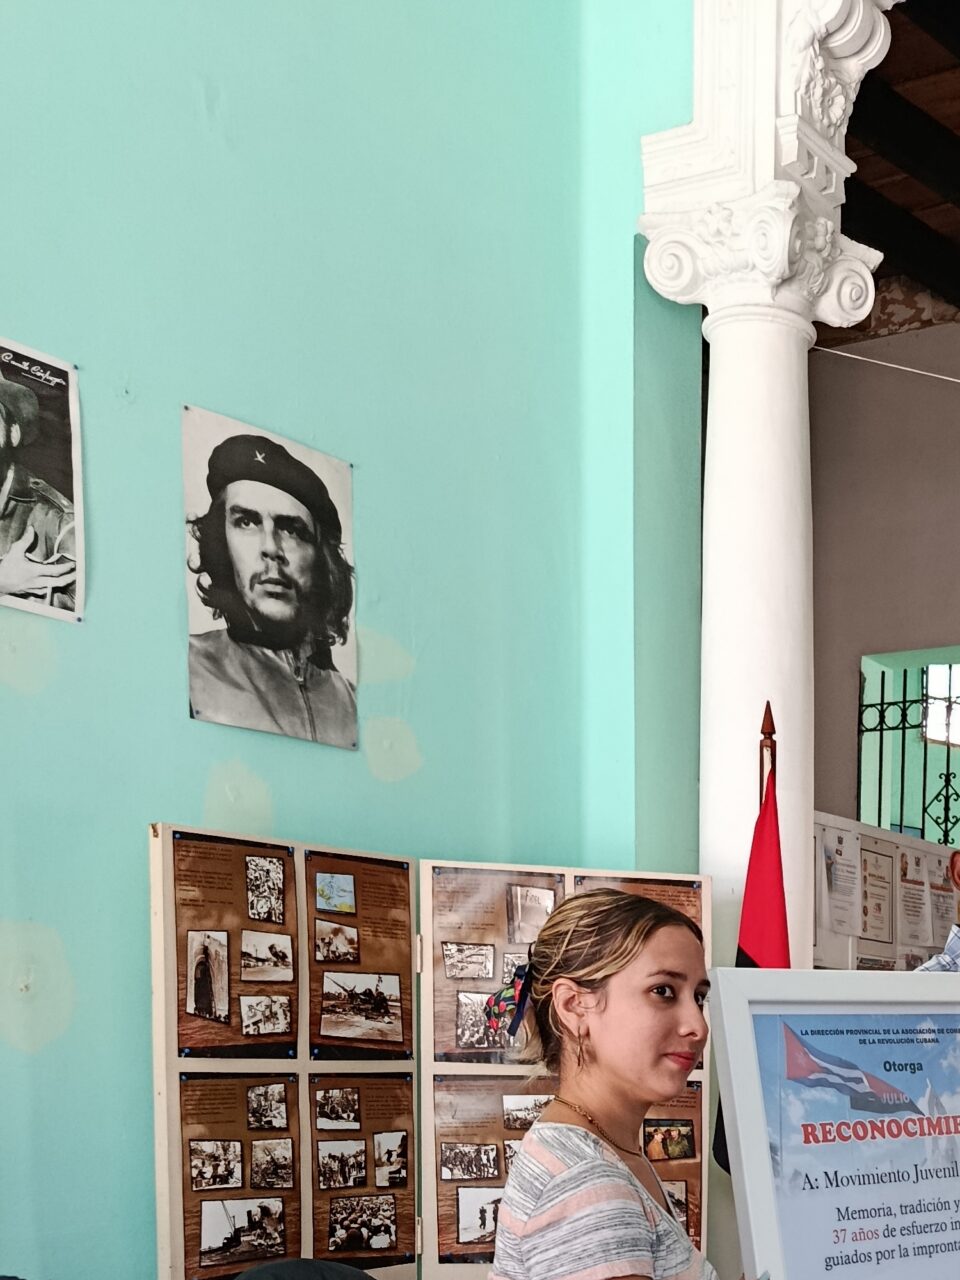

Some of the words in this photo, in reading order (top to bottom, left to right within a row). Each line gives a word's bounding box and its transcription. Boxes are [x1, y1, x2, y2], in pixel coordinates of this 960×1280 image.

[810, 1028, 845, 1036] DIRECCIÓN
[901, 1027, 936, 1035] ASOCIACIÓN
[878, 1036, 916, 1045] REVOLUCIÓN
[883, 1060, 924, 1075] Otorga
[881, 1092, 910, 1105] JULIO
[802, 1172, 820, 1191] A:
[823, 1166, 910, 1189] Movimiento
[912, 1161, 960, 1184] Juvenil
[836, 1203, 897, 1222] Memoria,
[900, 1198, 951, 1216] tradición
[954, 1198, 960, 1214] y
[832, 1229, 847, 1244] 37
[852, 1227, 880, 1242] años
[882, 1224, 897, 1239] de
[899, 1221, 948, 1237] esfuerzo
[824, 1250, 872, 1272] guiados
[876, 1248, 896, 1266] por
[900, 1244, 910, 1258] la
